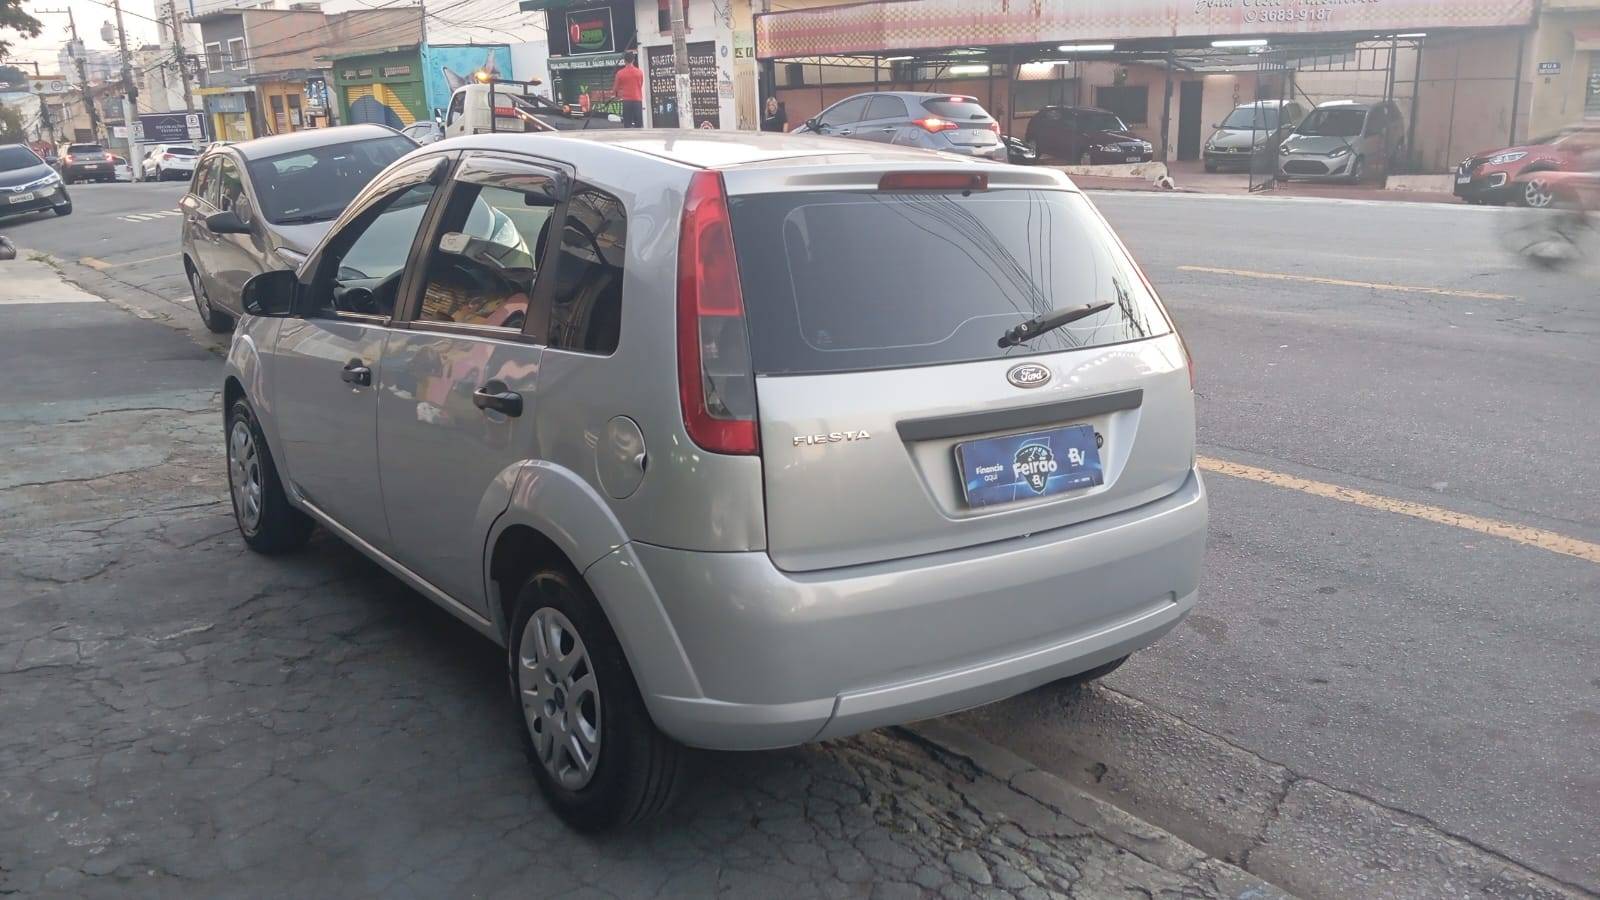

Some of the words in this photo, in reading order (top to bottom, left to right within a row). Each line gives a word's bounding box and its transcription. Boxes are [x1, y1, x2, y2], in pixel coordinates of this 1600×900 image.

[1260, 8, 1335, 22] 3683-9187
[689, 55, 714, 65] SUJEITO
[652, 79, 676, 93] GARAG
[793, 429, 871, 446] FIESTA
[975, 463, 1004, 475] Financie
[1012, 456, 1058, 479] Feirão
[984, 474, 999, 483] aqui
